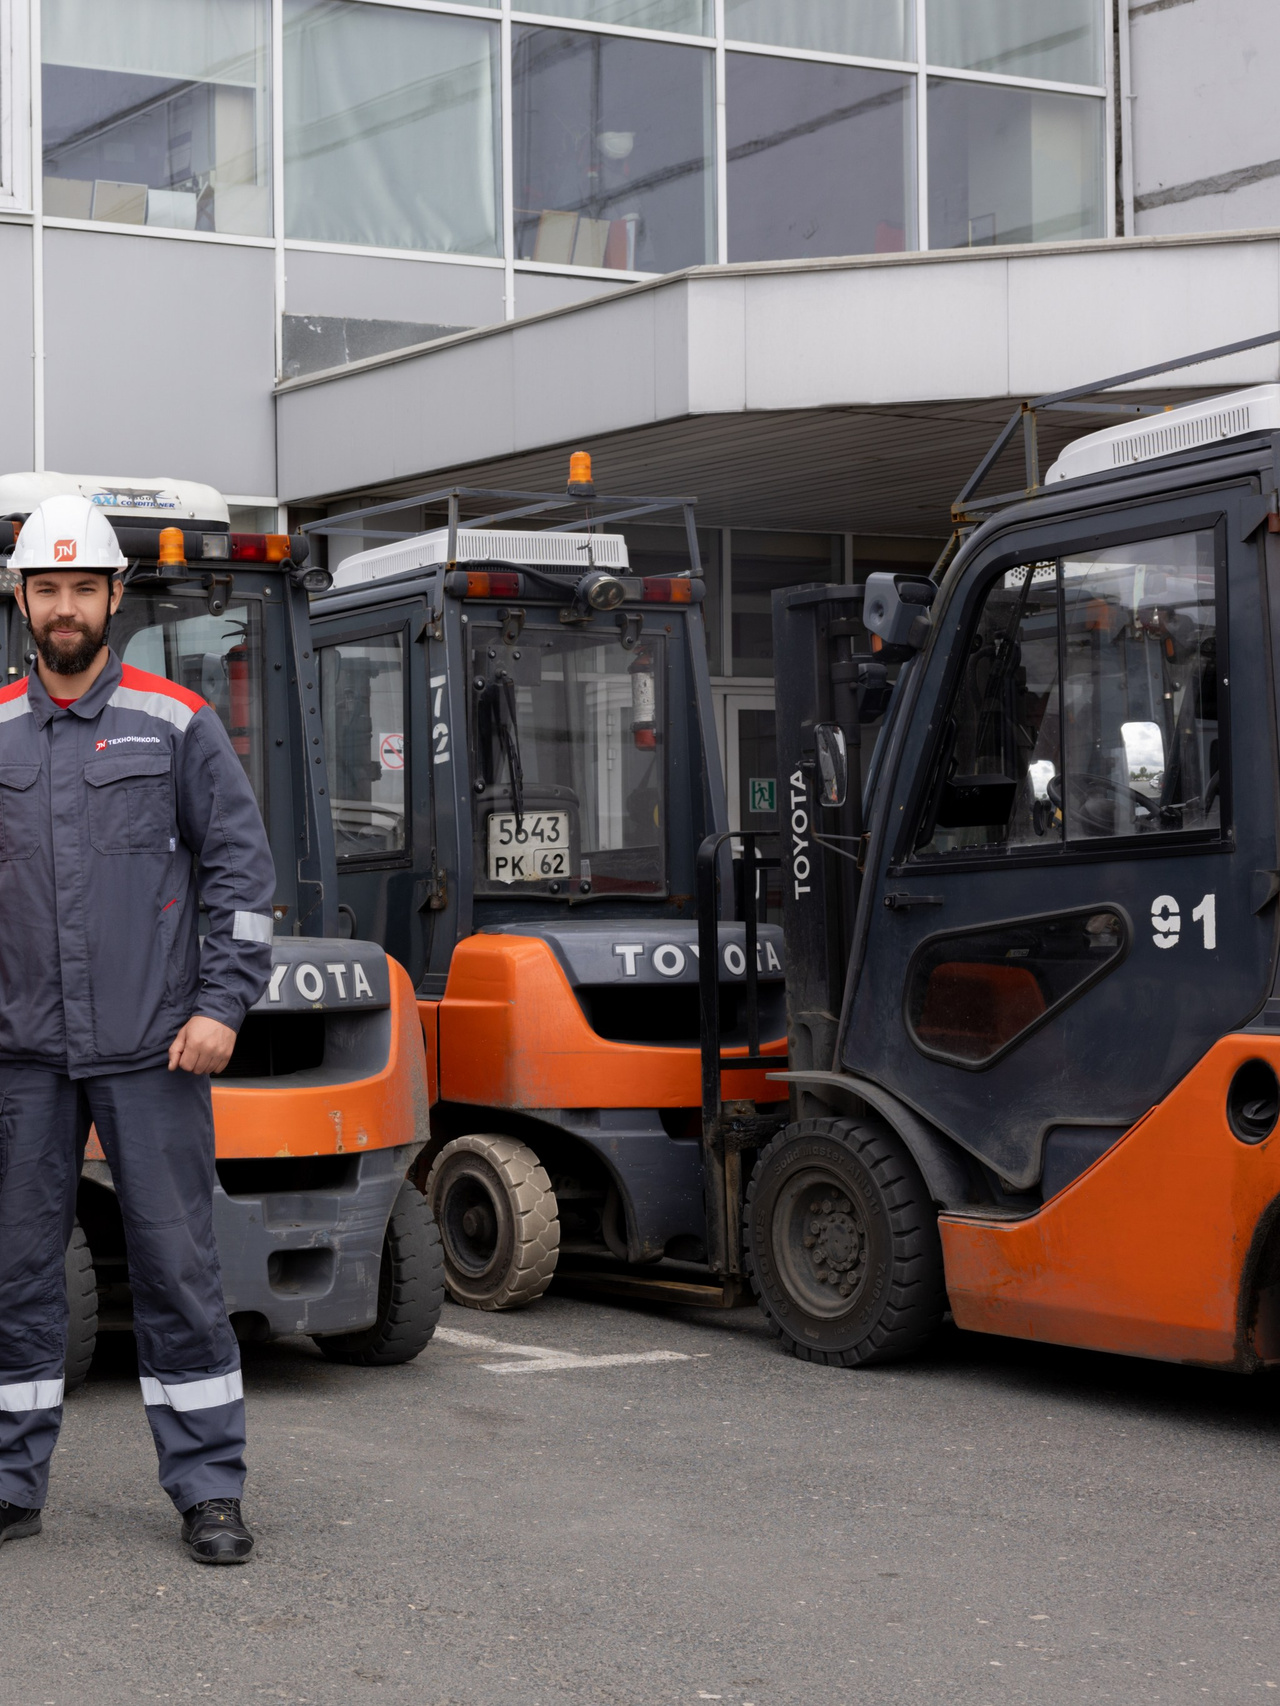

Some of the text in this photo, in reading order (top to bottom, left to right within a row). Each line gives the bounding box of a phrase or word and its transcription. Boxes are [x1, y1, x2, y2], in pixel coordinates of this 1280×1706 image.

[790, 770, 811, 900] TOYOTA
[541, 854, 564, 875] 62
[1151, 894, 1216, 950] 91
[269, 963, 374, 1002] YOTA
